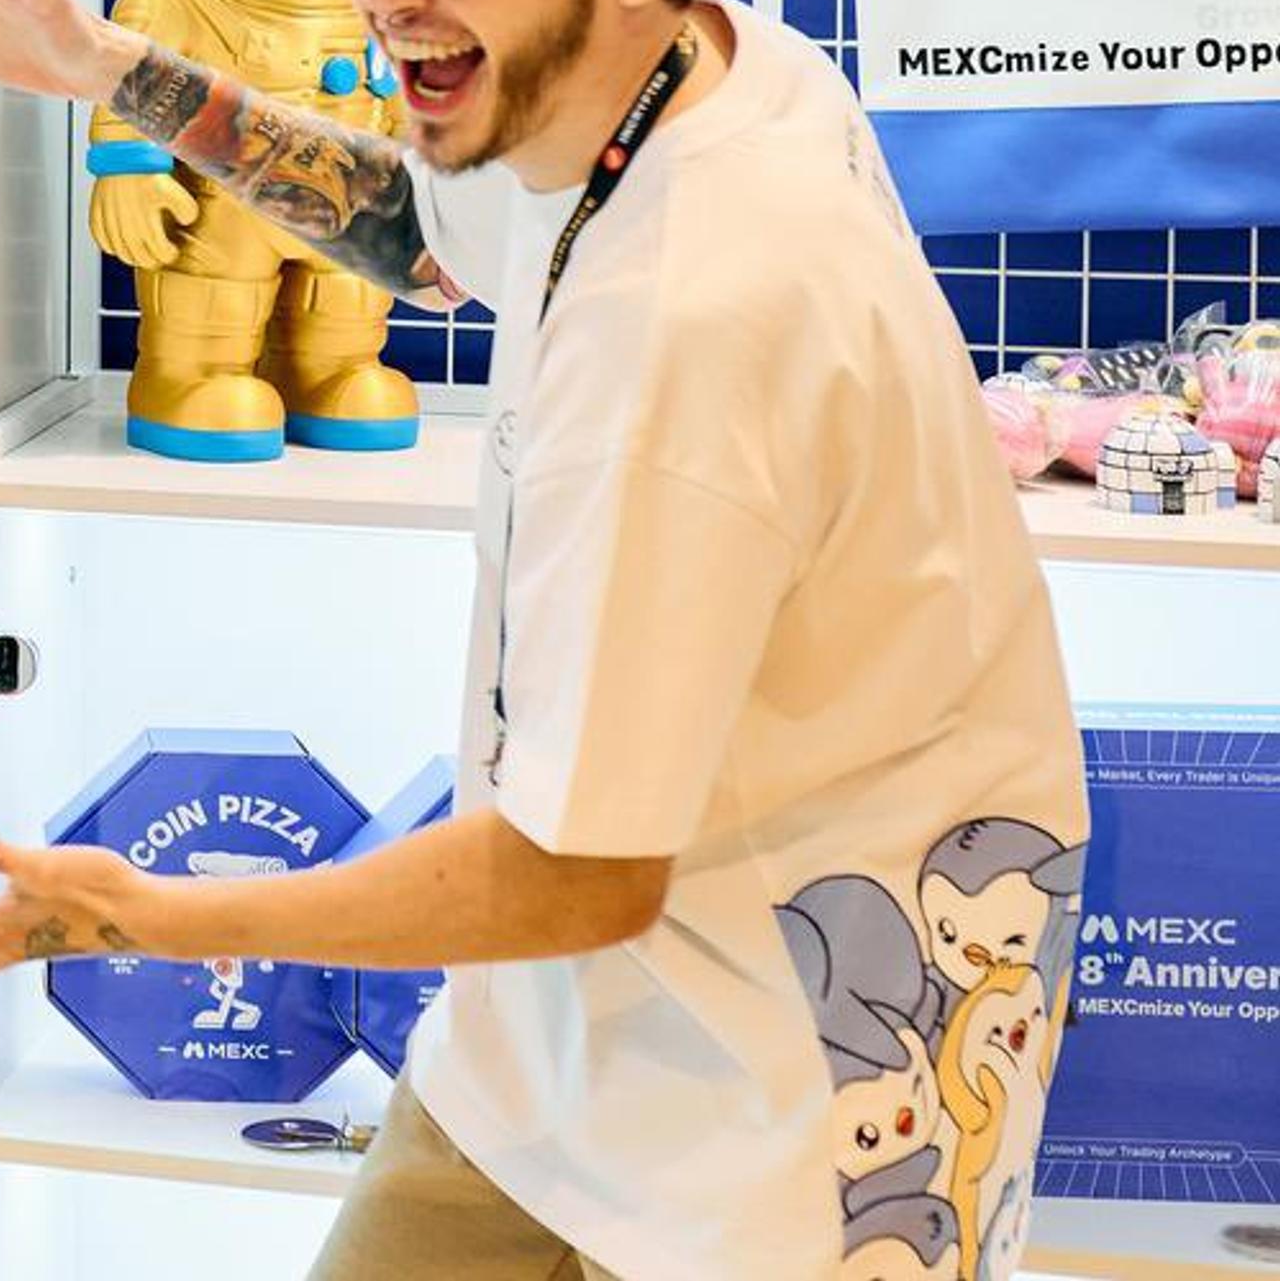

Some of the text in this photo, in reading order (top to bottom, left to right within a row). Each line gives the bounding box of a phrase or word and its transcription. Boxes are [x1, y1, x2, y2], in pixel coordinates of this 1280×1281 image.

[898, 47, 1090, 77] MEXCmize
[1099, 42, 1186, 71] Your
[1147, 770, 1182, 786] Every
[129, 794, 320, 867] COIN PIZZA
[1126, 917, 1236, 945] MEXC
[1078, 997, 1185, 1017] MEXCmize
[1188, 1000, 1234, 1018] Your
[208, 1043, 270, 1061] MEXC
